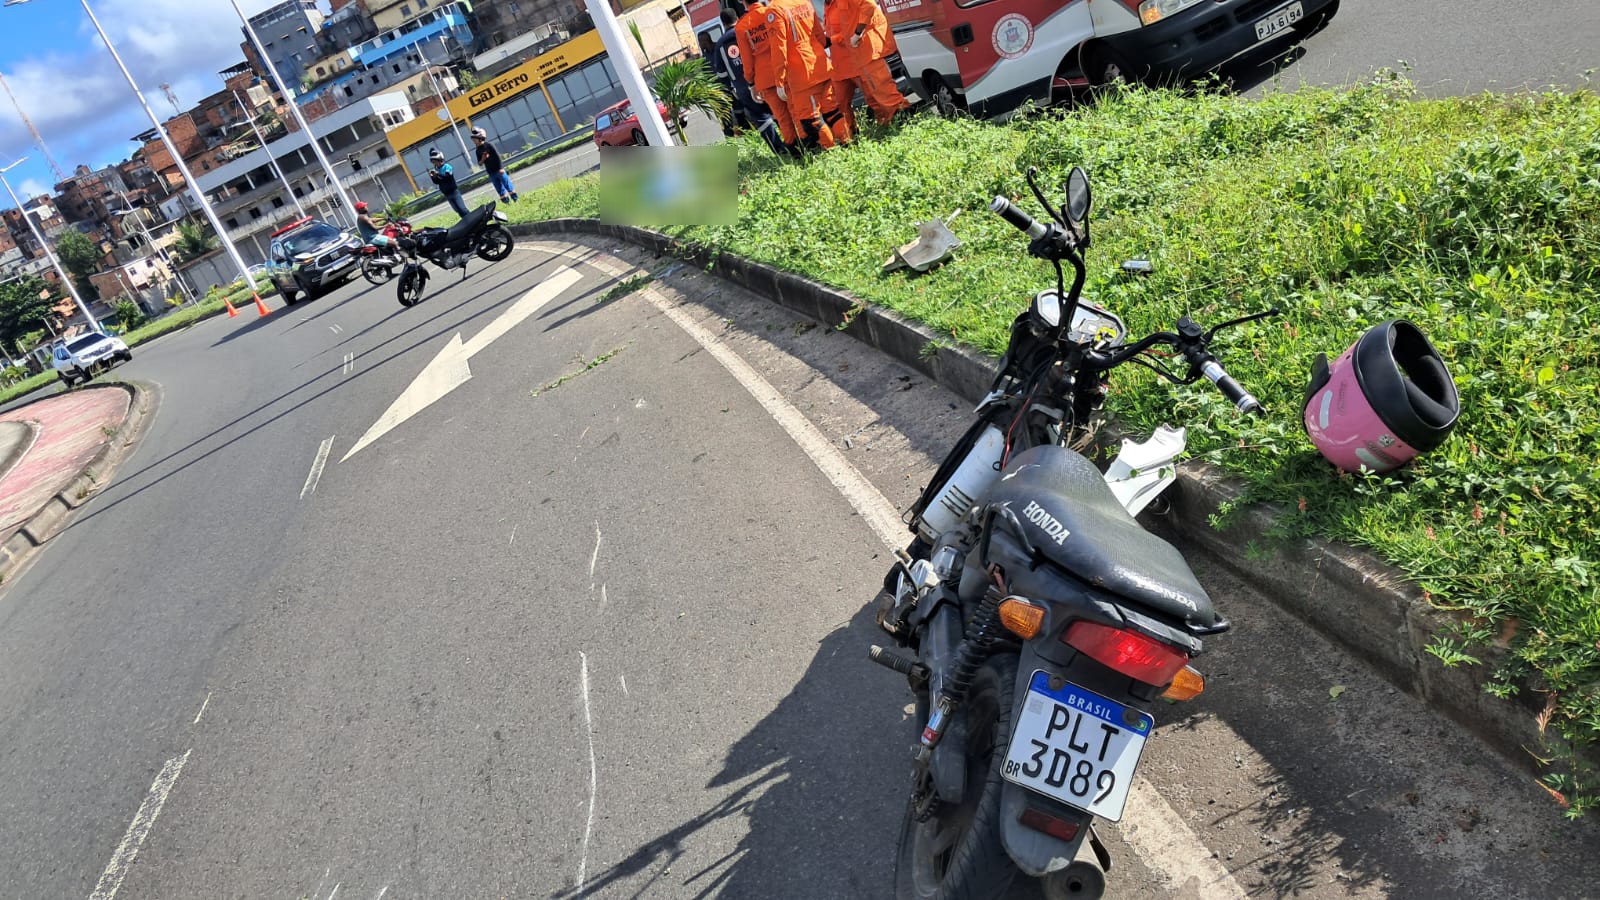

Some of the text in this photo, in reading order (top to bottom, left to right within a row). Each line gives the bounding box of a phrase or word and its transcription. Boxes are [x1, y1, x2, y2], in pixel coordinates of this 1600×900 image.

[1258, 9, 1302, 38] PJA-6194
[469, 73, 528, 107] Gal Ferro
[1022, 500, 1070, 545] HONDA
[1068, 694, 1112, 720] BRASIL
[1045, 703, 1120, 762] PLT
[1005, 739, 1116, 806] BR 3D89
